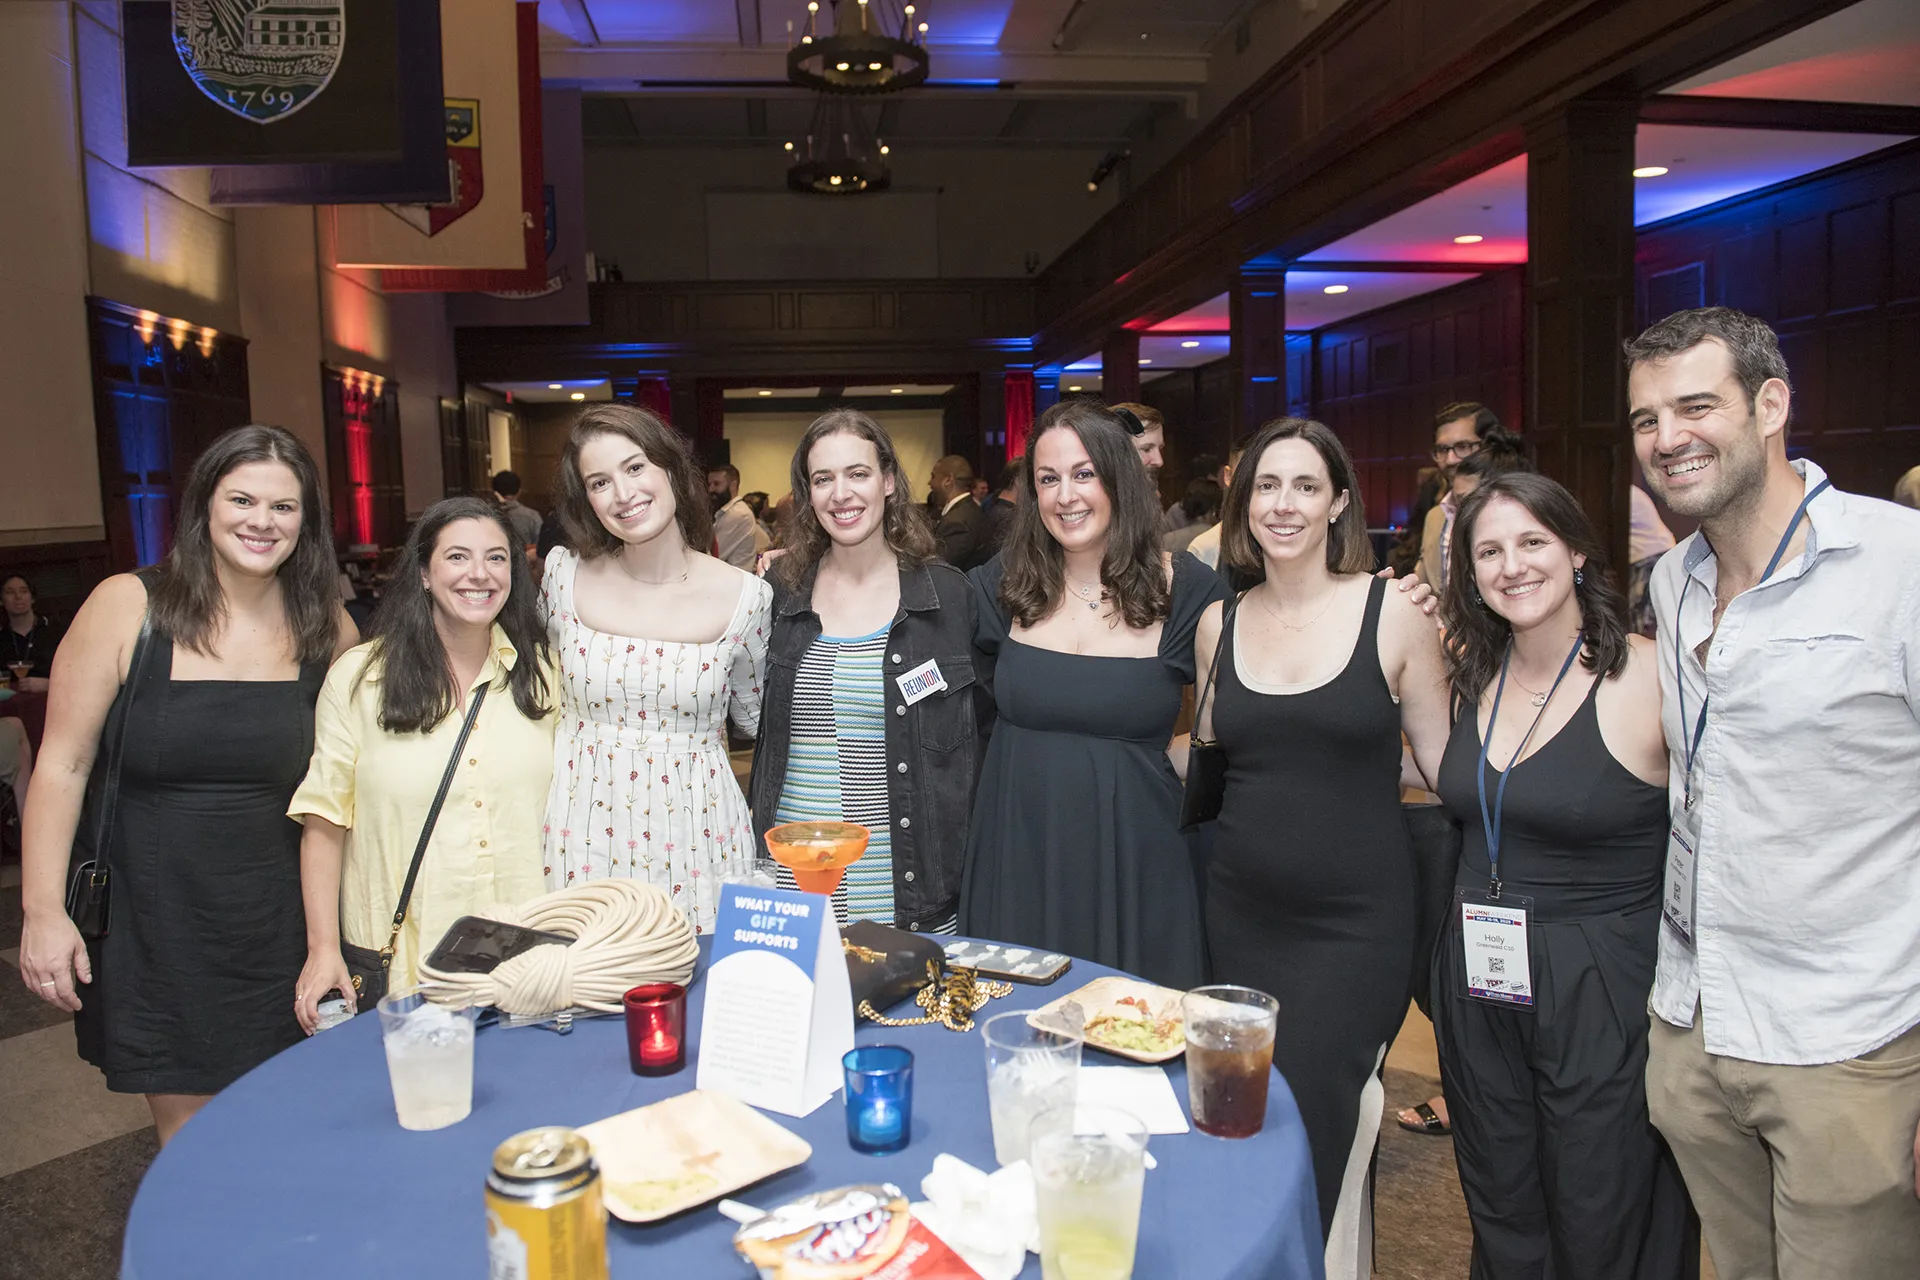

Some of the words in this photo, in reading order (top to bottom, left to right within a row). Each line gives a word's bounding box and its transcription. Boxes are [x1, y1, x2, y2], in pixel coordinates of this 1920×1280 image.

[227, 86, 294, 112] 1769
[734, 895, 770, 913] WHAT
[773, 901, 810, 918] YOUR
[750, 913, 788, 931] GIFT
[733, 929, 798, 950] SUPPORTS
[1476, 941, 1503, 950] Greenwald
[1484, 934, 1505, 945] Holly
[1485, 979, 1504, 988] PENN
